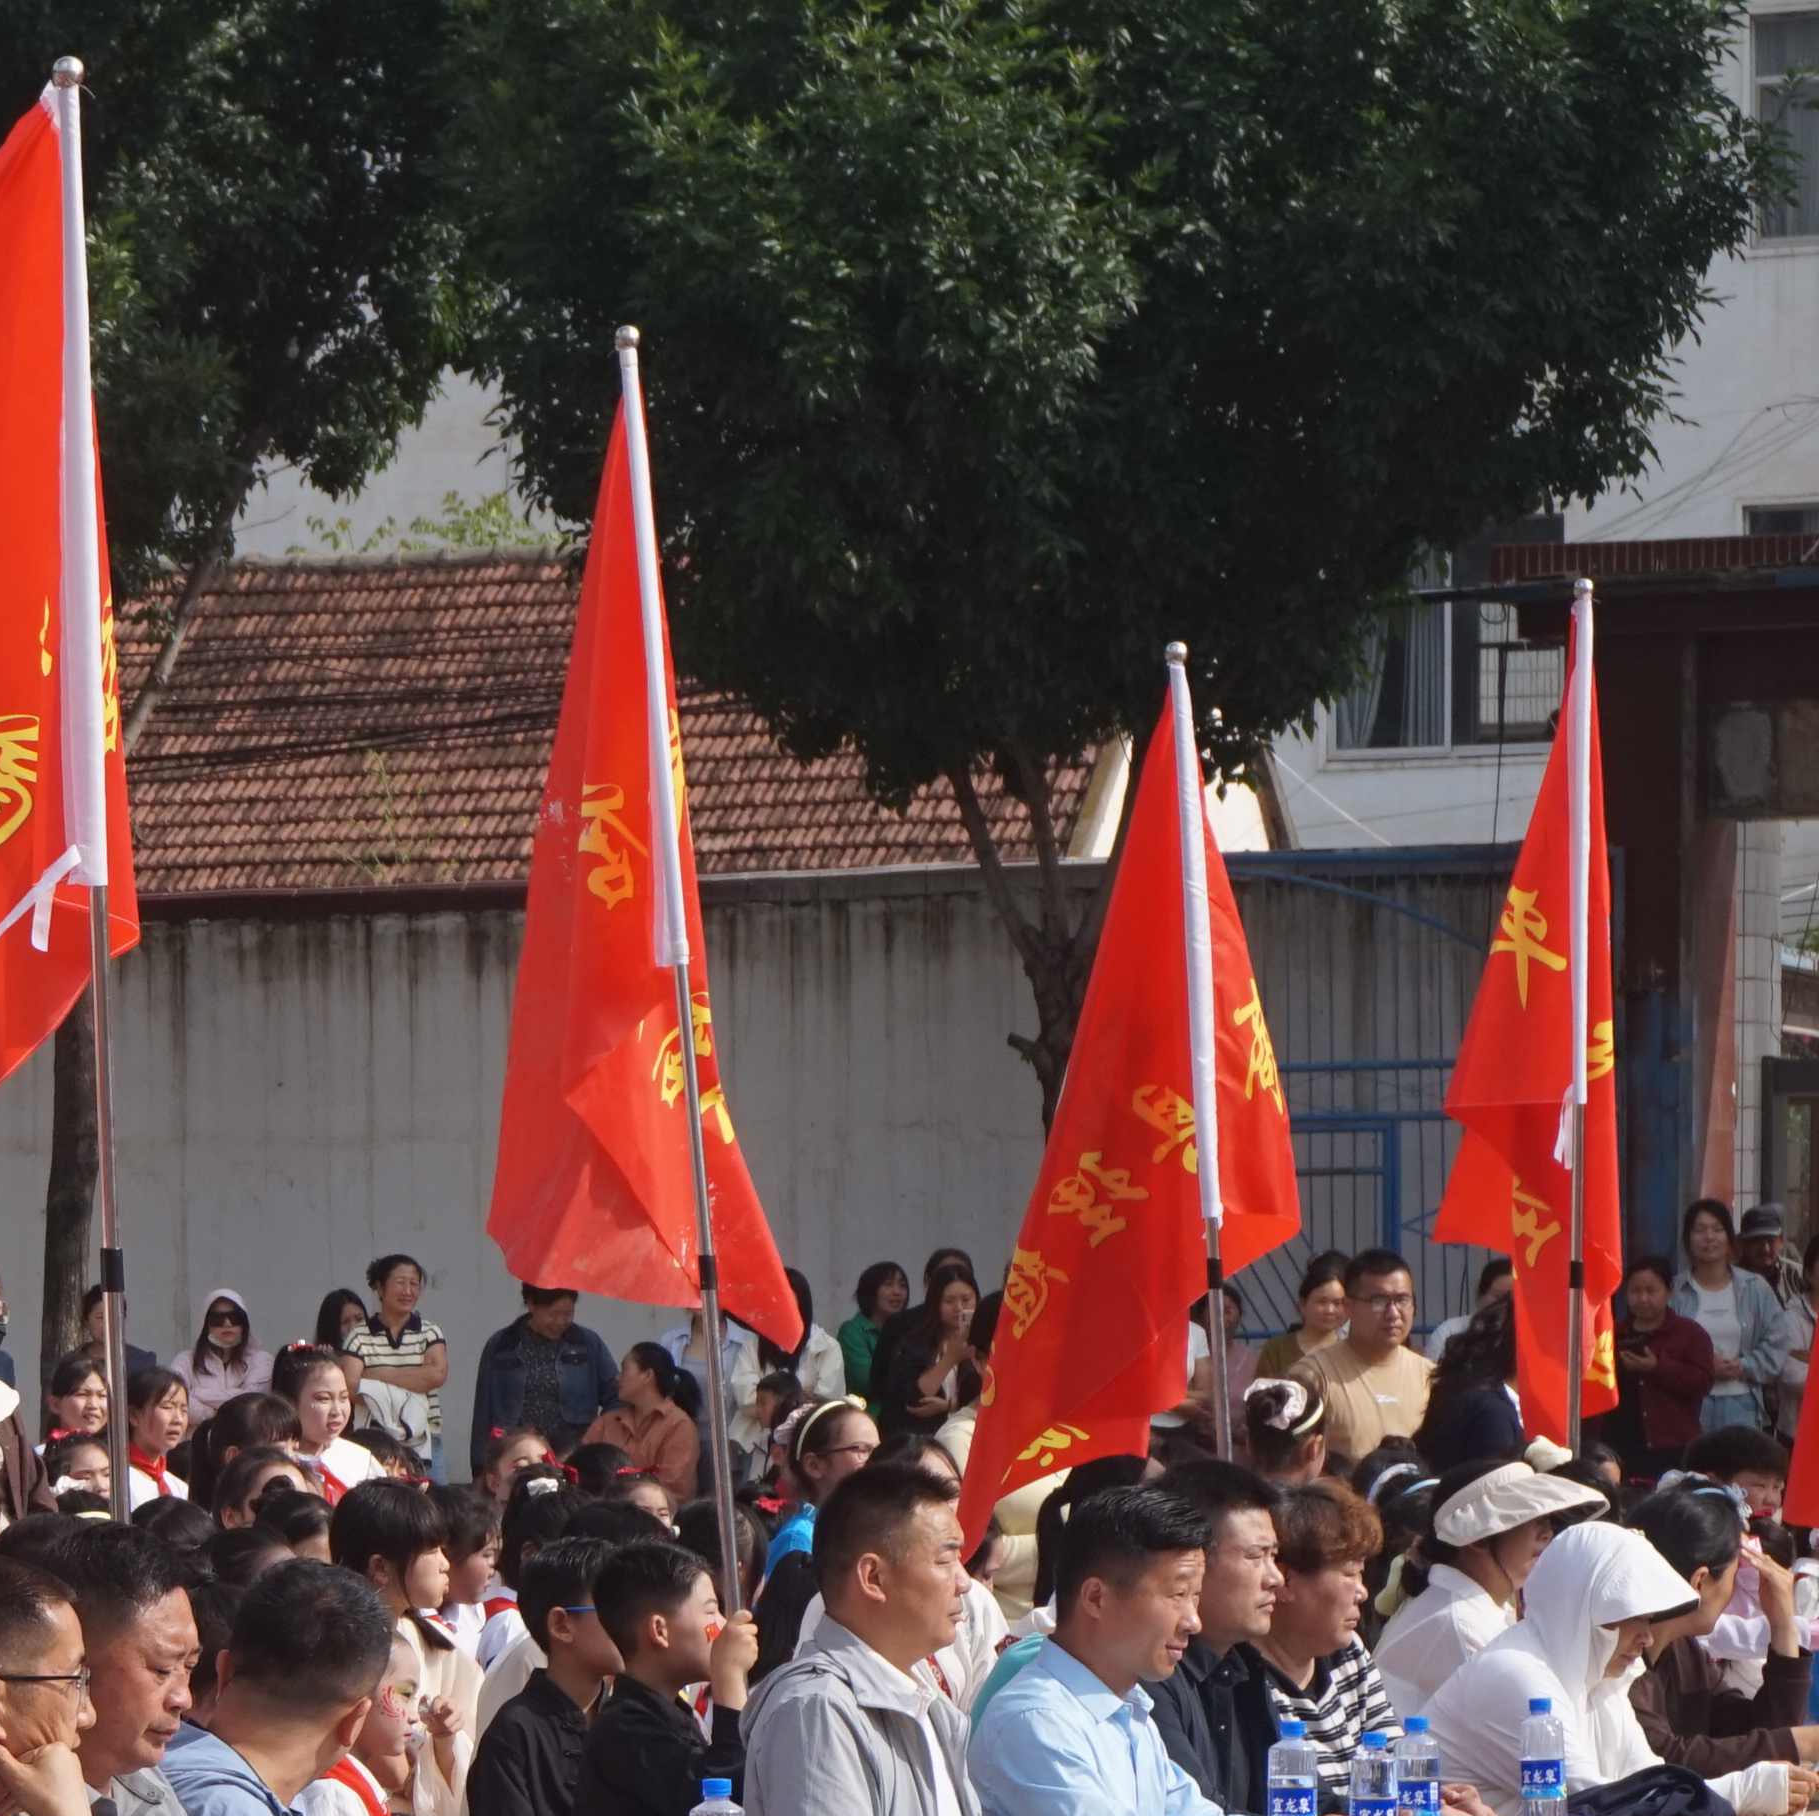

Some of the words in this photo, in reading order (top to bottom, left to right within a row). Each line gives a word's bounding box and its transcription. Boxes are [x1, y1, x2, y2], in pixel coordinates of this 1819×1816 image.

[1398, 1788, 1427, 1805] 龙泉
[1272, 1797, 1311, 1813] 宜龙泉
